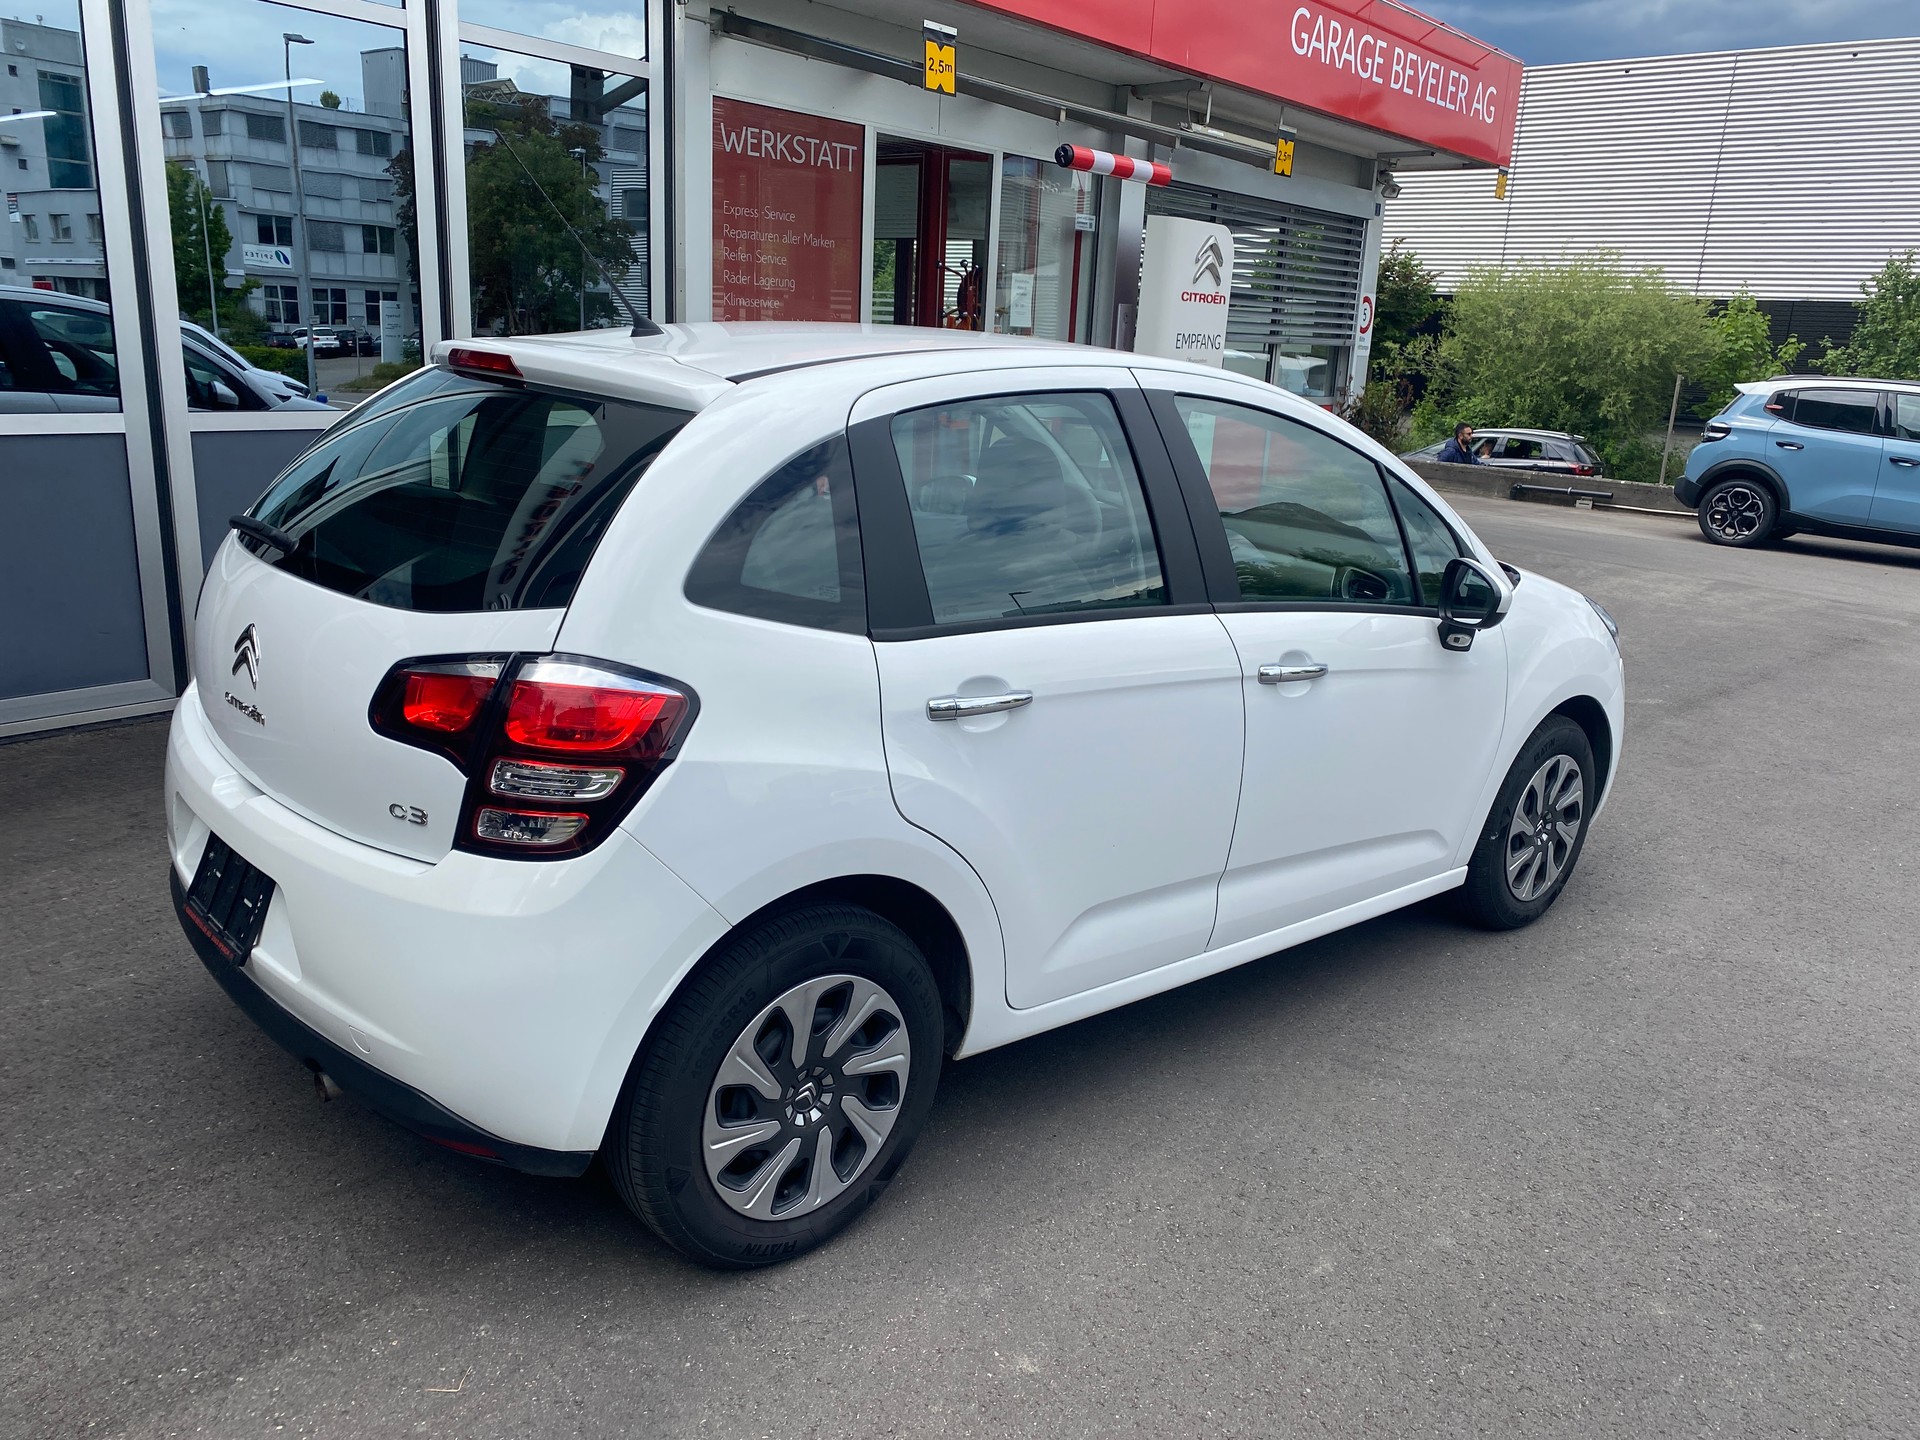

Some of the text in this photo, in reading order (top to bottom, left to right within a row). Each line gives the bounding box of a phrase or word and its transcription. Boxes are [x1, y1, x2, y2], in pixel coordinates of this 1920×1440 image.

[928, 57, 953, 75] 2,5m
[1291, 7, 1498, 124] GARAGE BEYELER AG
[721, 122, 857, 172] WERKSTATT
[723, 200, 759, 219] Express
[723, 223, 835, 249] Reparaturen aller Marken
[723, 246, 788, 266] Reifen Service
[723, 269, 796, 292] Räder Lagerung
[723, 292, 780, 309] Klimaservice
[1362, 308, 1368, 322] 5
[1175, 333, 1222, 350] EMPFANG
[389, 803, 428, 827] C3
